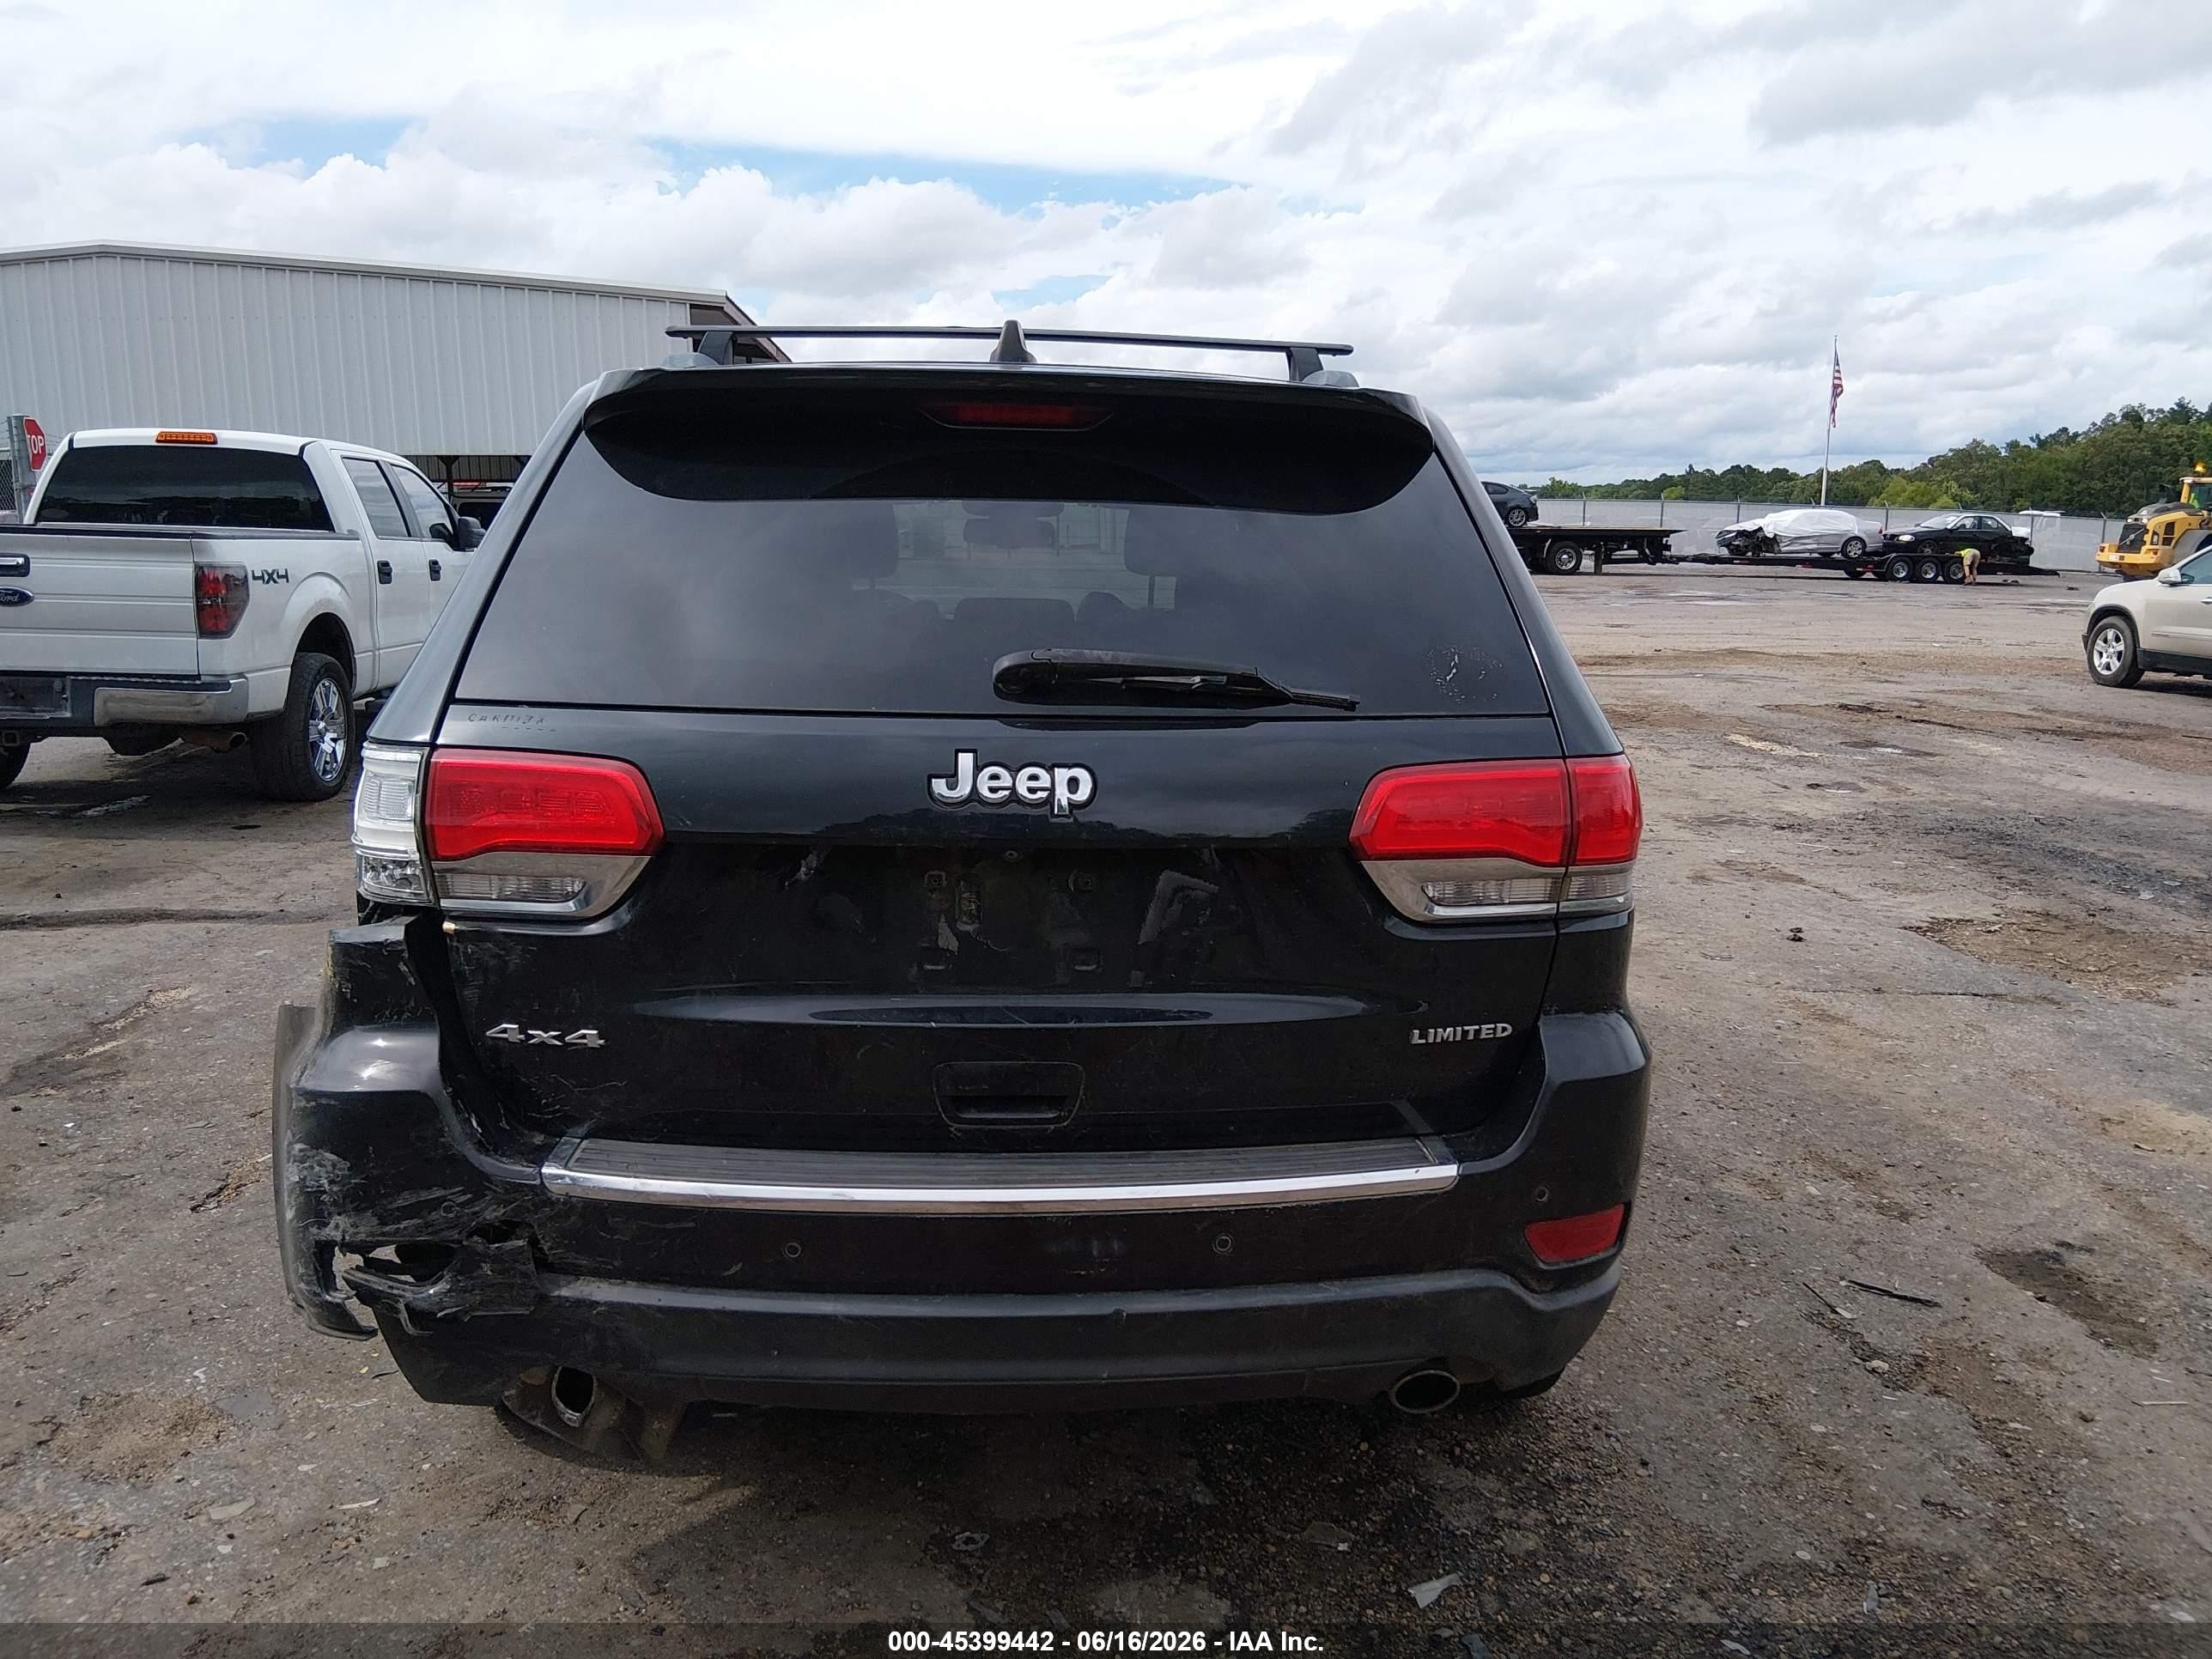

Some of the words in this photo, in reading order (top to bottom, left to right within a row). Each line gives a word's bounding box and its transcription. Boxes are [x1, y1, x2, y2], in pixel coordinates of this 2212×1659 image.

[27, 434, 45, 454] TOP
[930, 751, 1094, 816] Jeep
[485, 1024, 605, 1048] 4x4
[1410, 1023, 1512, 1045] LIMITED
